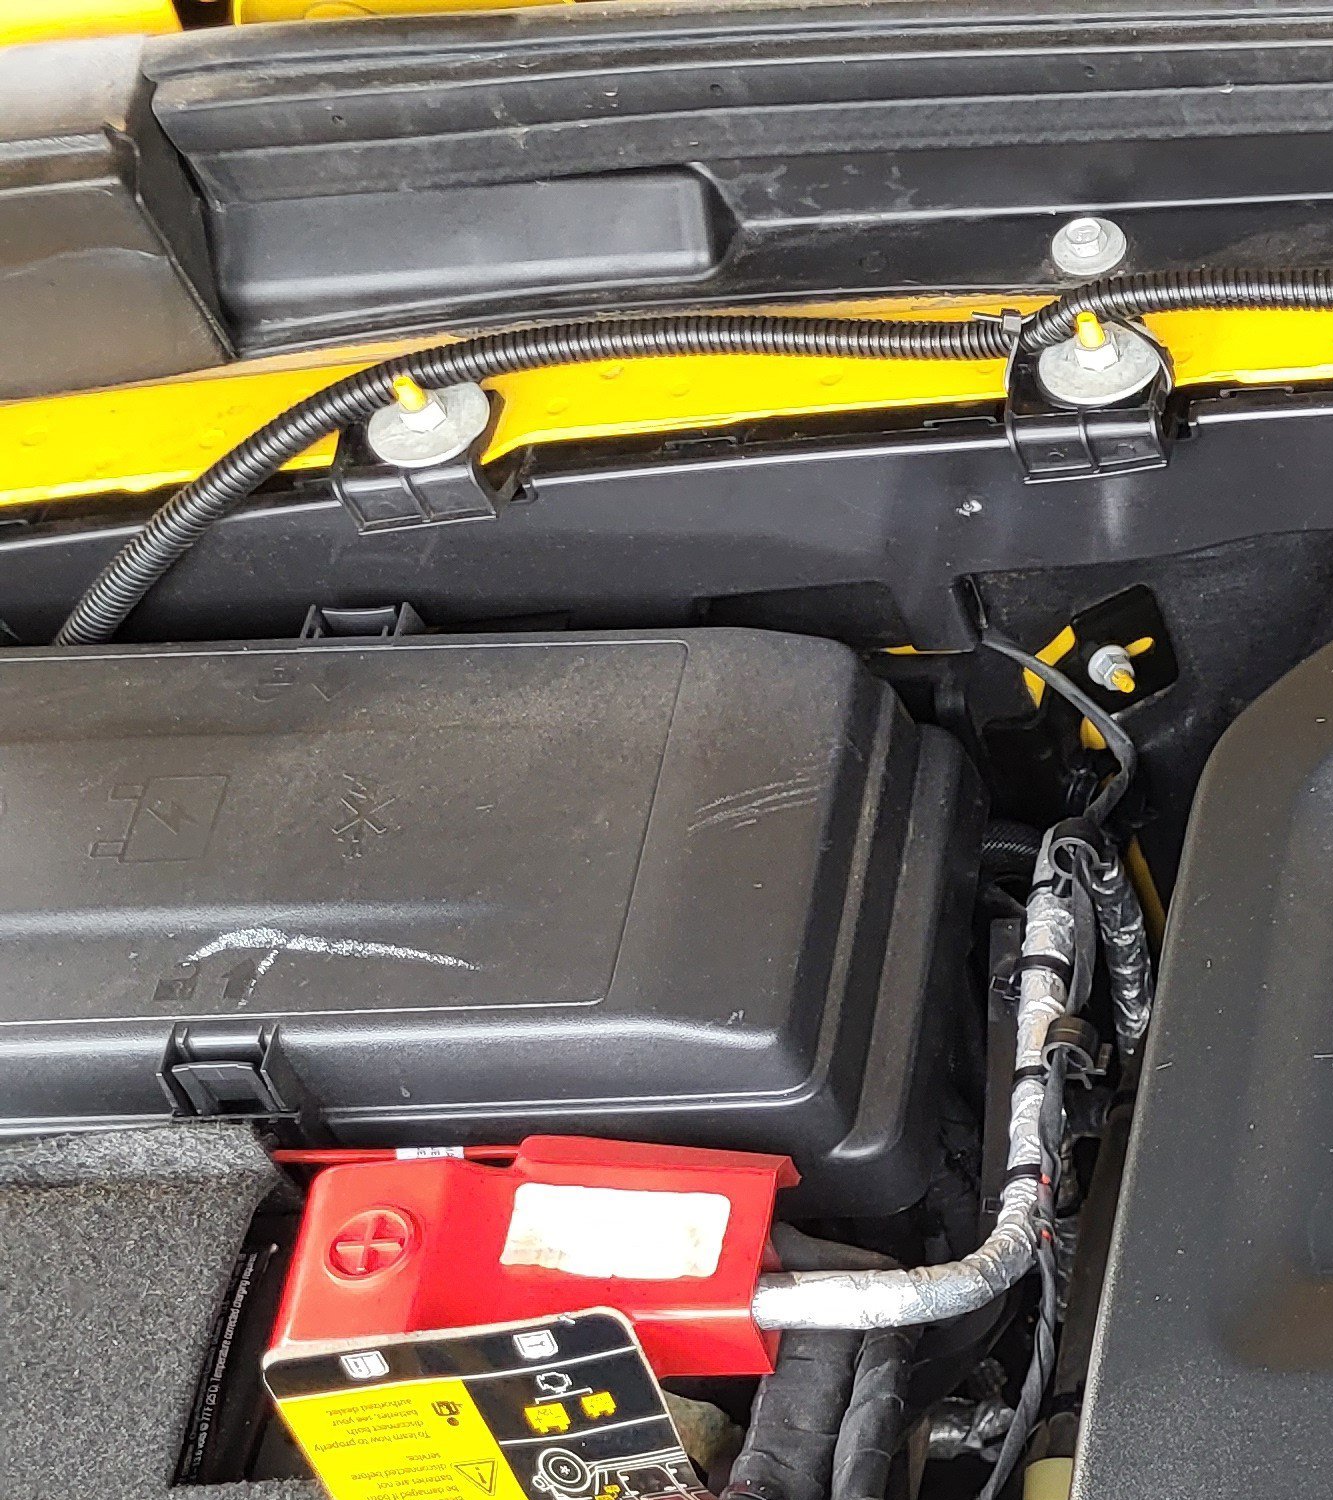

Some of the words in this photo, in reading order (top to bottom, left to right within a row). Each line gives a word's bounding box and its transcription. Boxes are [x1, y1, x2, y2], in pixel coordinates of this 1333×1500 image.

[331, 1416, 355, 1427] your
[371, 1420, 424, 1432] disconnect
[346, 1426, 372, 1436] both
[370, 1435, 392, 1443] how
[392, 1432, 417, 1441] learn
[314, 1437, 357, 1453] properly
[350, 1471, 384, 1481] before
[383, 1463, 447, 1479] disconnected
[394, 1479, 411, 1487] are
[411, 1474, 454, 1486] batteries
[376, 1481, 394, 1490] not
[446, 1485, 460, 1493] be
[399, 1488, 445, 1500] damaged
